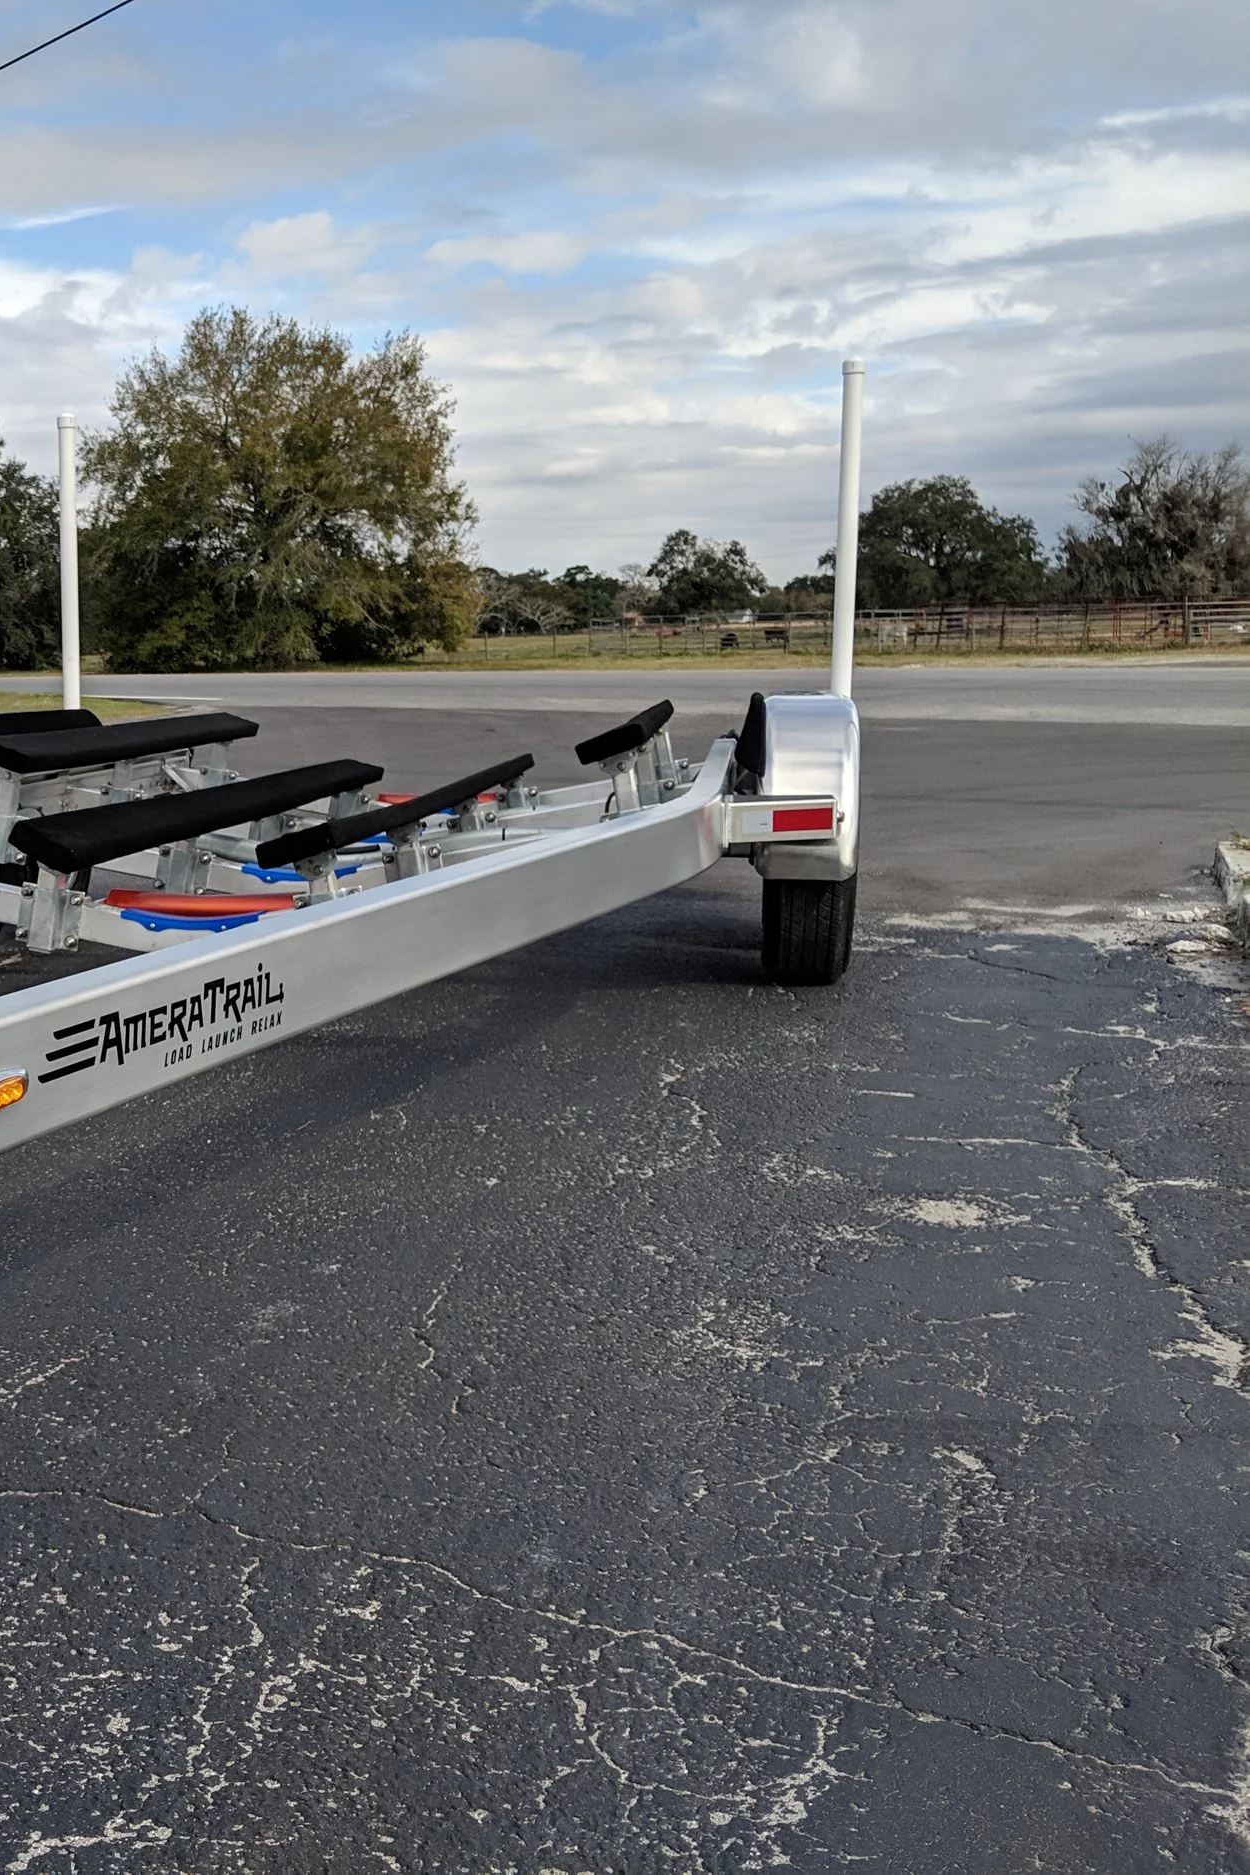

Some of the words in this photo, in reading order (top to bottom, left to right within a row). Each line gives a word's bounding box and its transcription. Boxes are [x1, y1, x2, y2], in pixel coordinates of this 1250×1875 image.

[164, 1044, 192, 1067] LOAD
[202, 1025, 243, 1055] LAUNCH
[251, 1011, 283, 1036] RELAX
